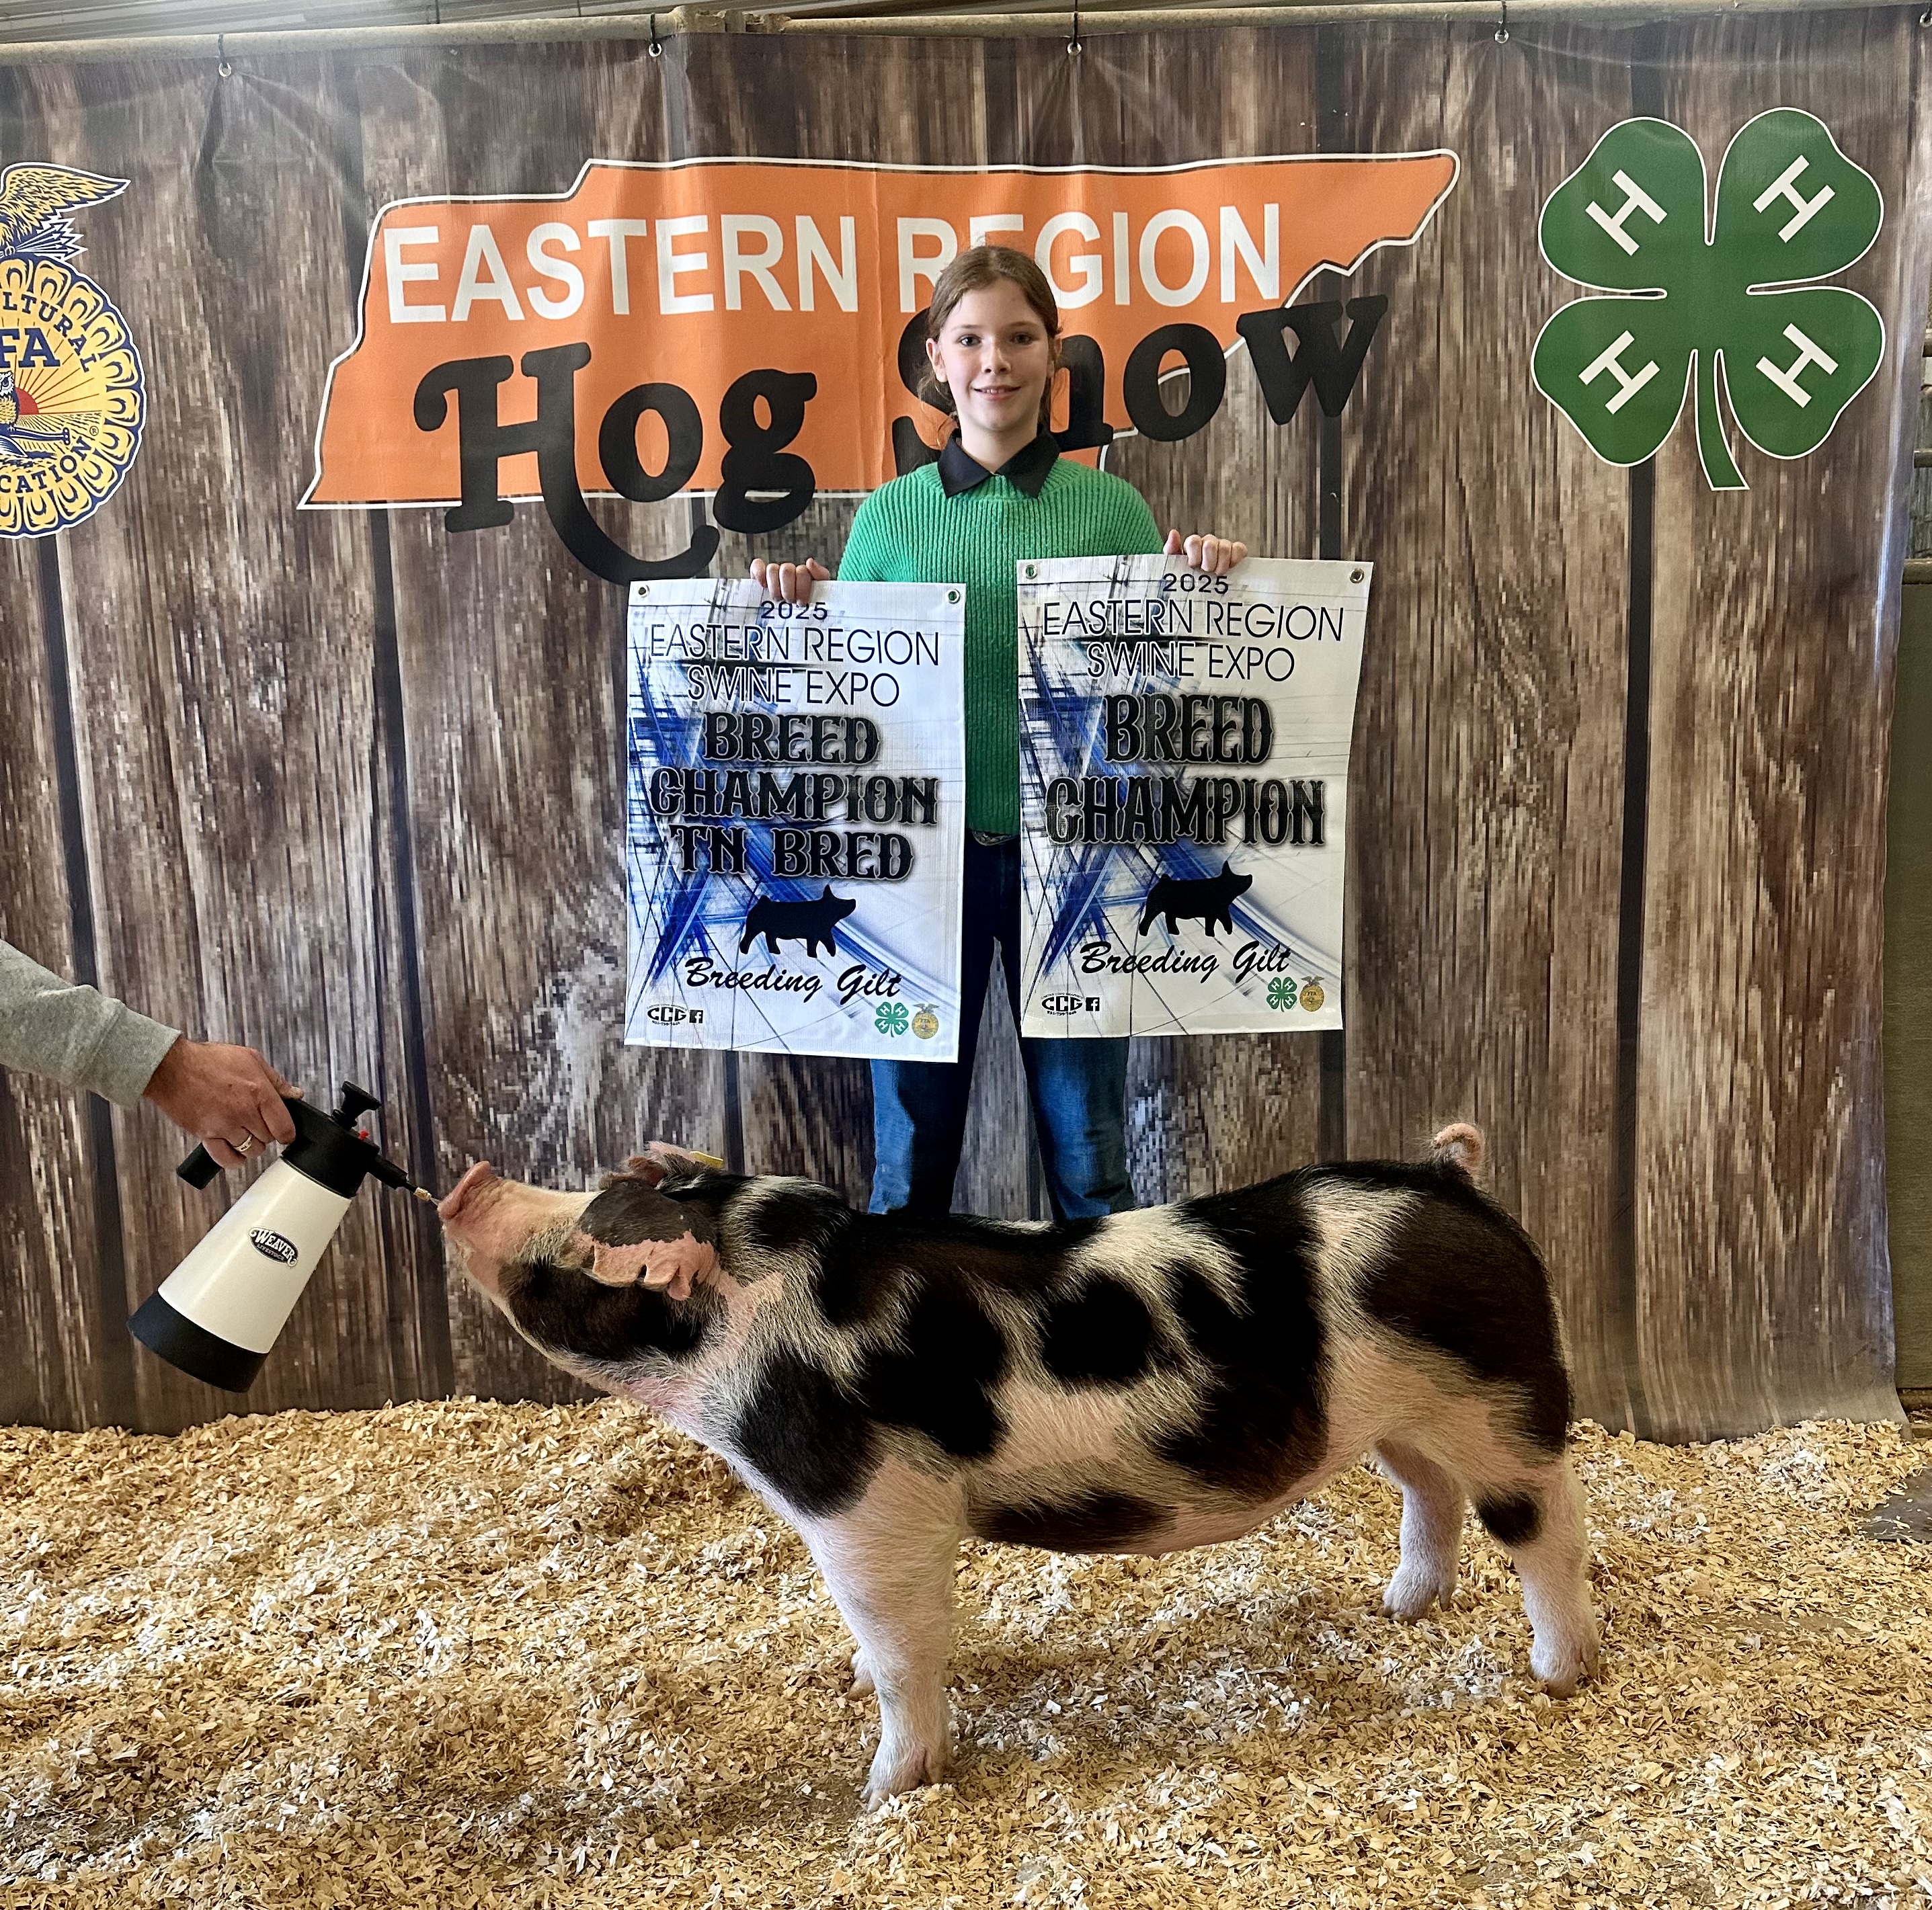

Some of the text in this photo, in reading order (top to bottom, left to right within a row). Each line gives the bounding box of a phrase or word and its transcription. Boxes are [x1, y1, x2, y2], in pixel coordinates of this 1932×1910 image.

[1585, 155, 1835, 256] H H
[383, 214, 858, 323] EASTERN
[1578, 323, 1839, 415] H H
[413, 341, 817, 585] Hog
[1163, 573, 1229, 594] 2025
[761, 601, 828, 620] 2025
[1044, 599, 1343, 641] EASTERN REGION
[651, 624, 938, 666] EASTERN REGION
[1087, 641, 1295, 681] SWINE EXPO
[688, 667, 899, 707] SWINE EXPO
[703, 711, 881, 765] BREED
[1104, 694, 1274, 765] BREED
[649, 767, 940, 825] CHAMPION
[1045, 776, 1326, 845] CHAMPION
[670, 824, 914, 881] TN BRED
[686, 957, 901, 1005] Breeding Gilt
[1080, 940, 1291, 984] Breeding Gilt
[249, 1228, 298, 1267] WEAVER
